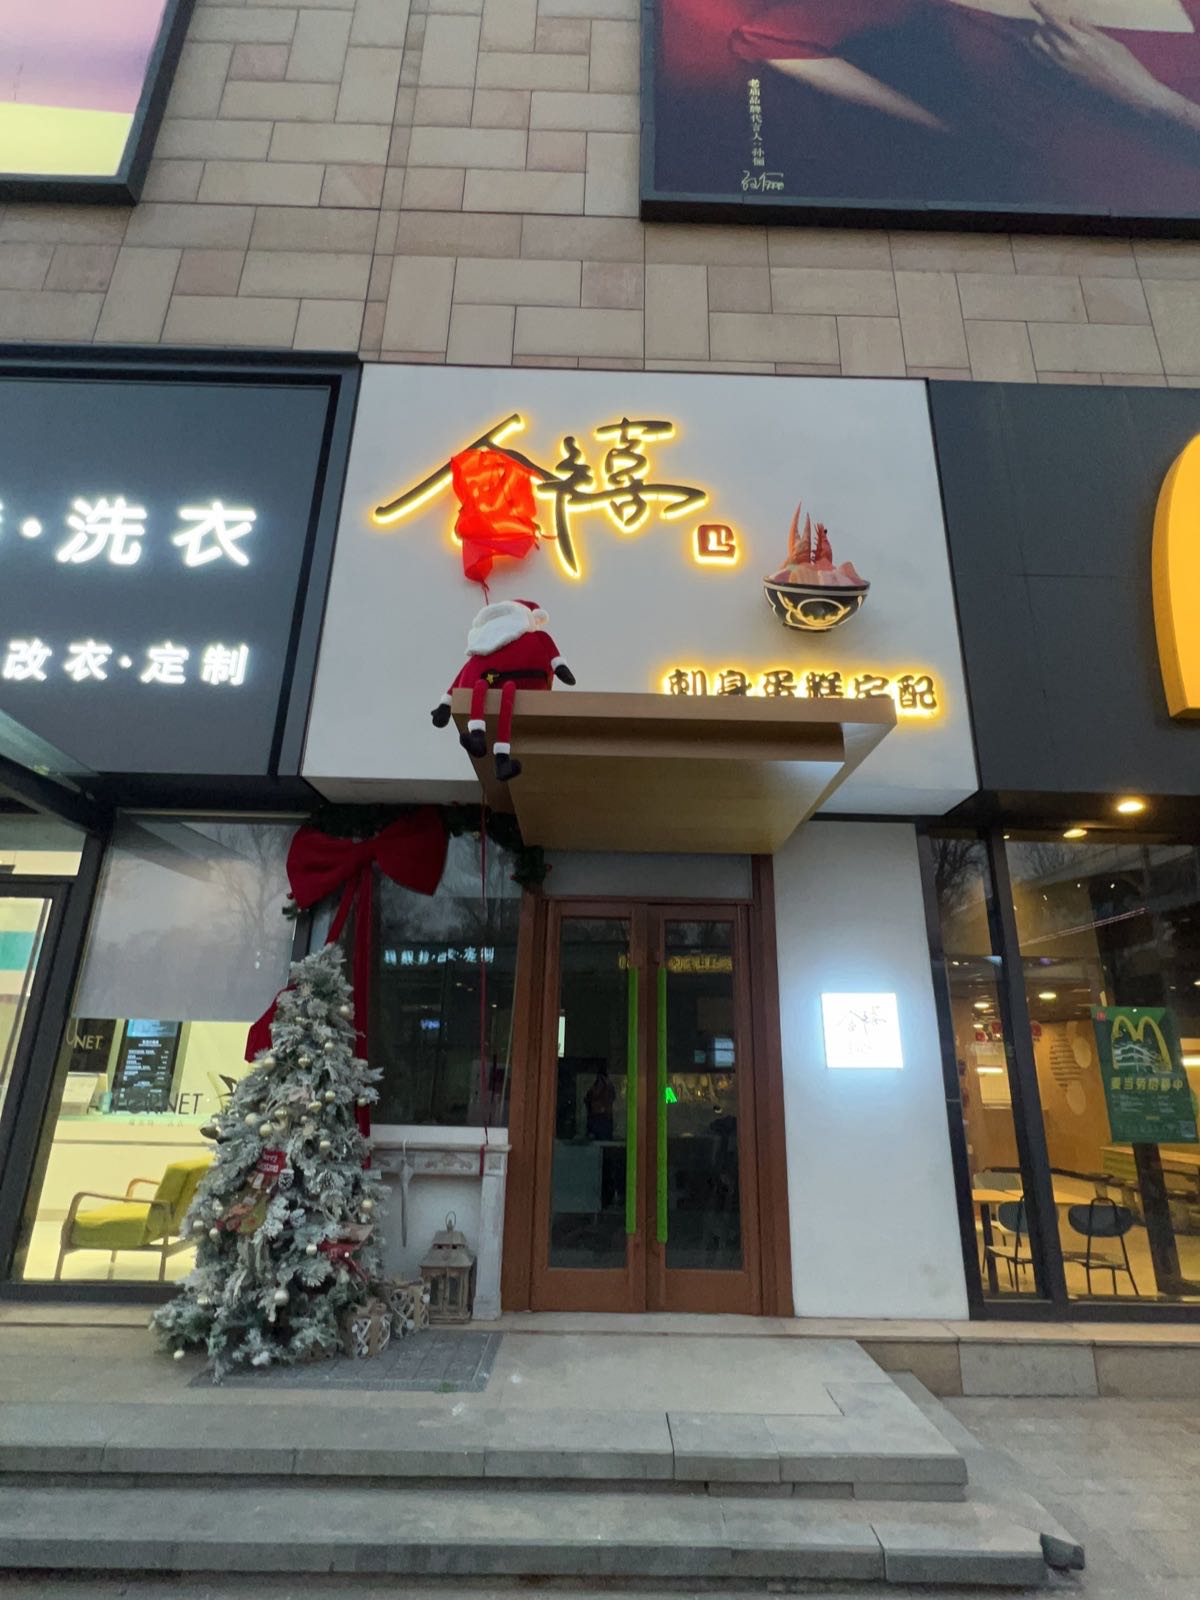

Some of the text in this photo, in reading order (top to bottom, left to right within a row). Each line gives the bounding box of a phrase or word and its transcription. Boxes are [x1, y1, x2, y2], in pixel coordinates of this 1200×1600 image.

[668, 659, 938, 710] 刺身蛋糕宅配
